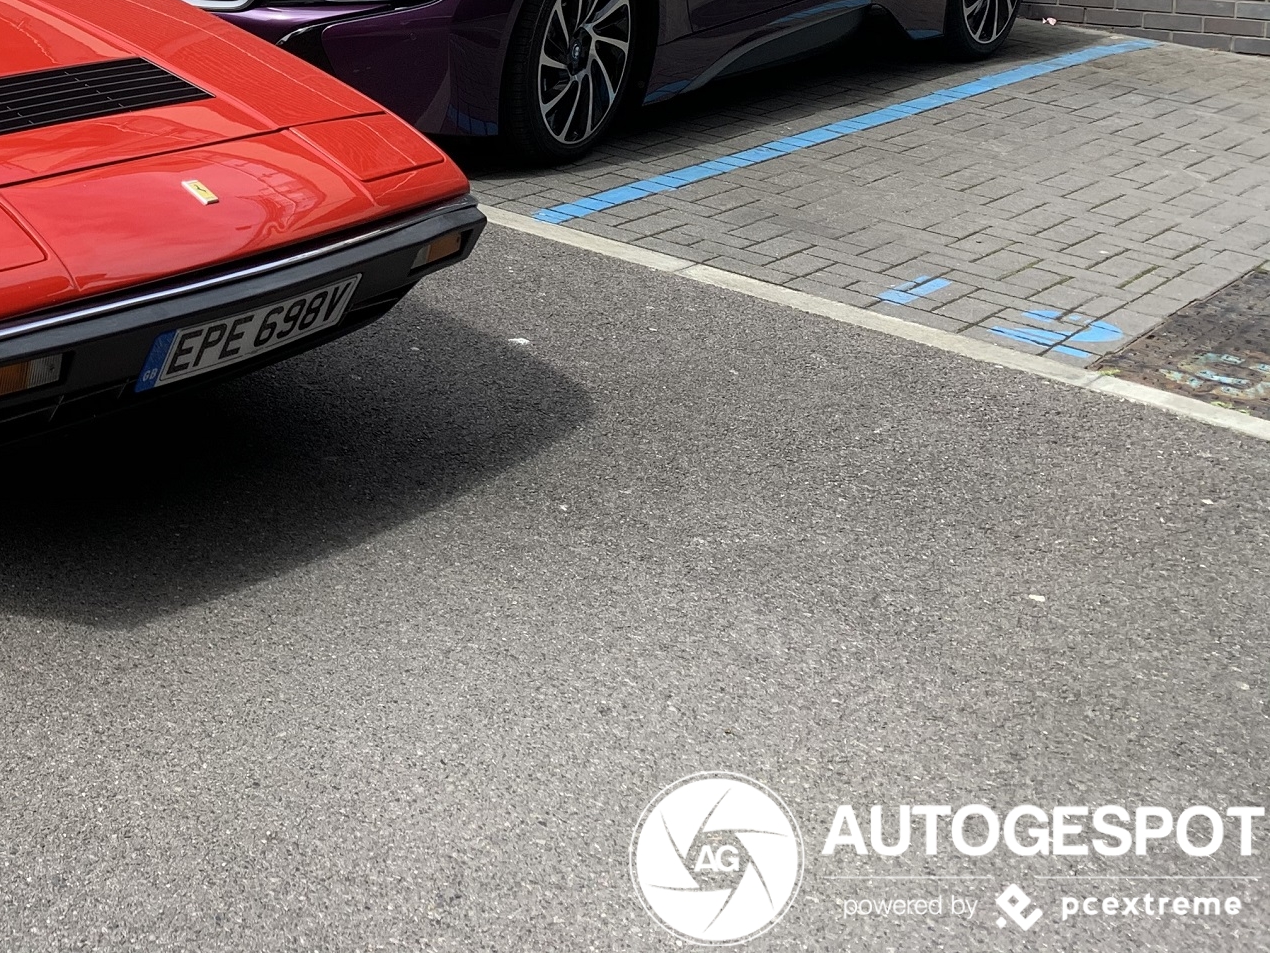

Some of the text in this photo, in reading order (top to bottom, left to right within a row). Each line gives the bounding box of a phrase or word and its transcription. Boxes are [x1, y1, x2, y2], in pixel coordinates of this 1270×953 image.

[166, 281, 352, 375] EPE 698V
[142, 367, 158, 382] GB
